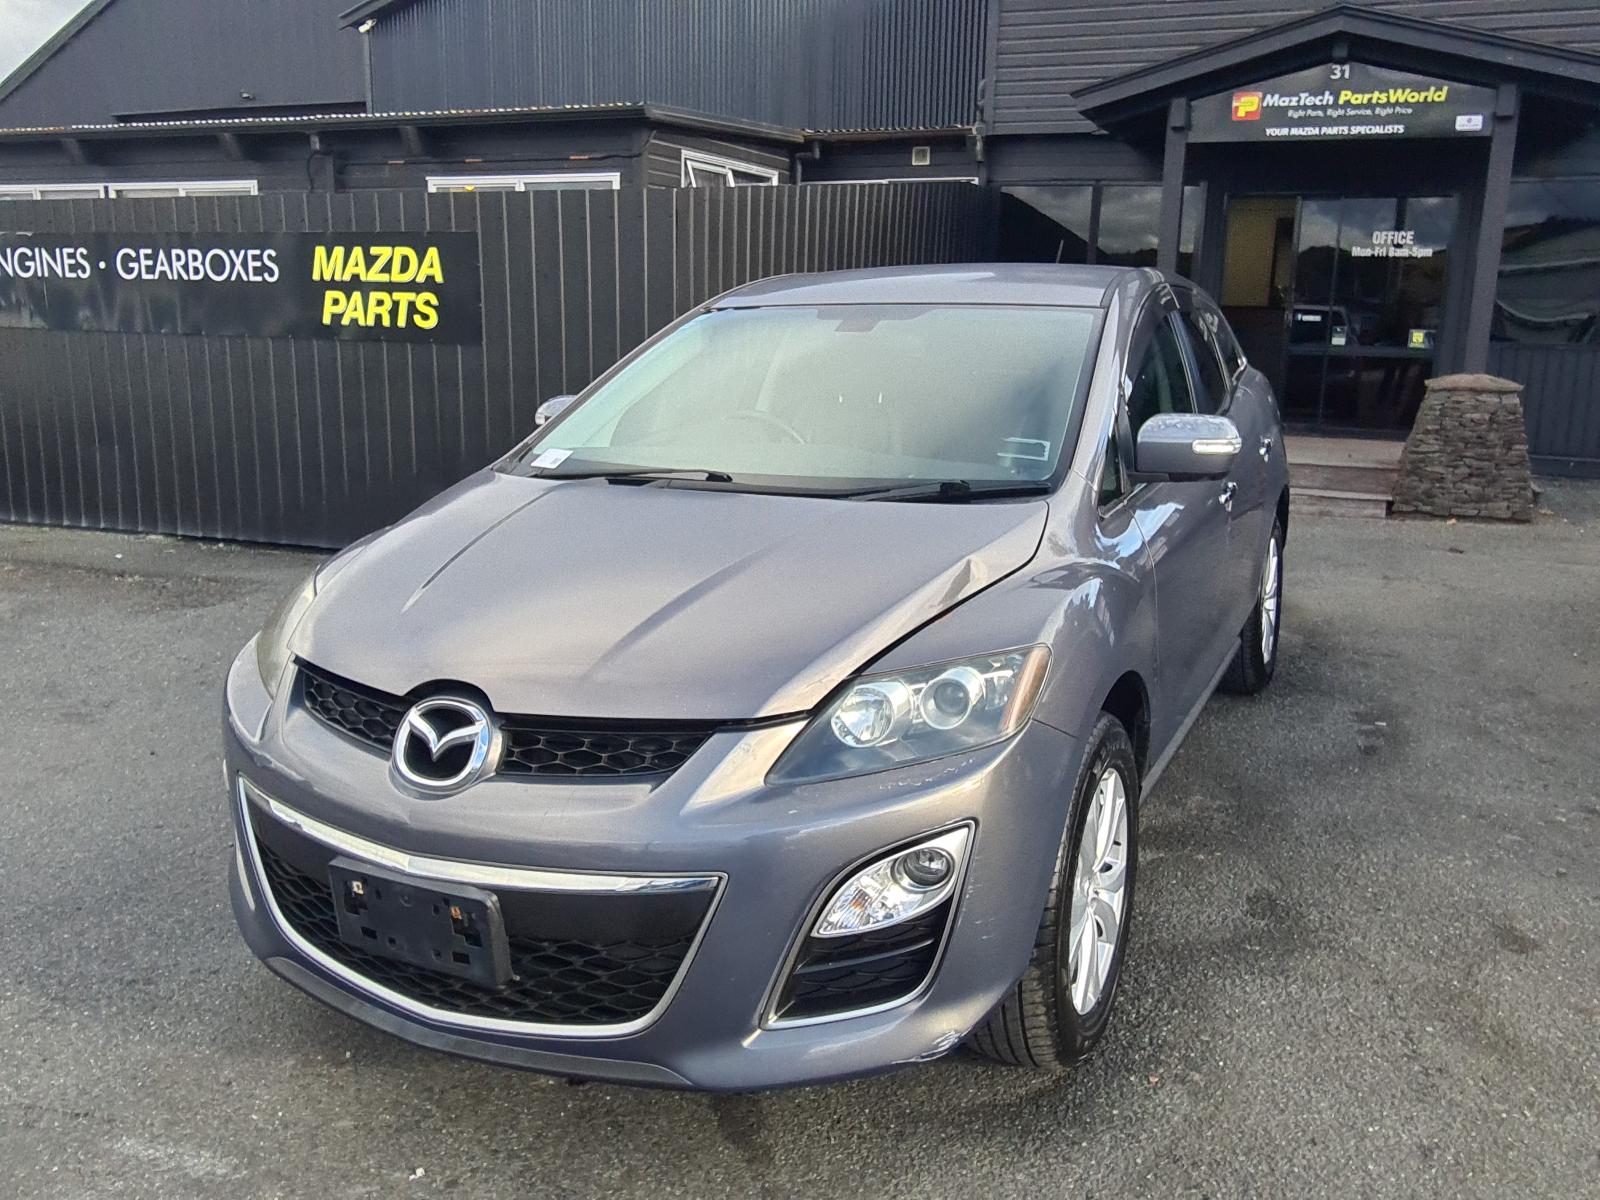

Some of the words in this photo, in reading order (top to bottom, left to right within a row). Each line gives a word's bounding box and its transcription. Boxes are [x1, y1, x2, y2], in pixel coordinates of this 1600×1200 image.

[1330, 64, 1350, 80] 31
[1262, 91, 1334, 107] MazTech
[1338, 86, 1448, 104] PartsWorld
[1265, 127, 1289, 136] YOUR
[1290, 127, 1319, 136] MAZDA
[1321, 126, 1349, 135] PARTS
[1350, 125, 1405, 135] SPECIALISTS
[1372, 230, 1415, 245] OFFICE
[115, 247, 280, 283] GEARBOXES
[312, 246, 444, 284] MAZDA
[322, 290, 440, 329] PARTS
